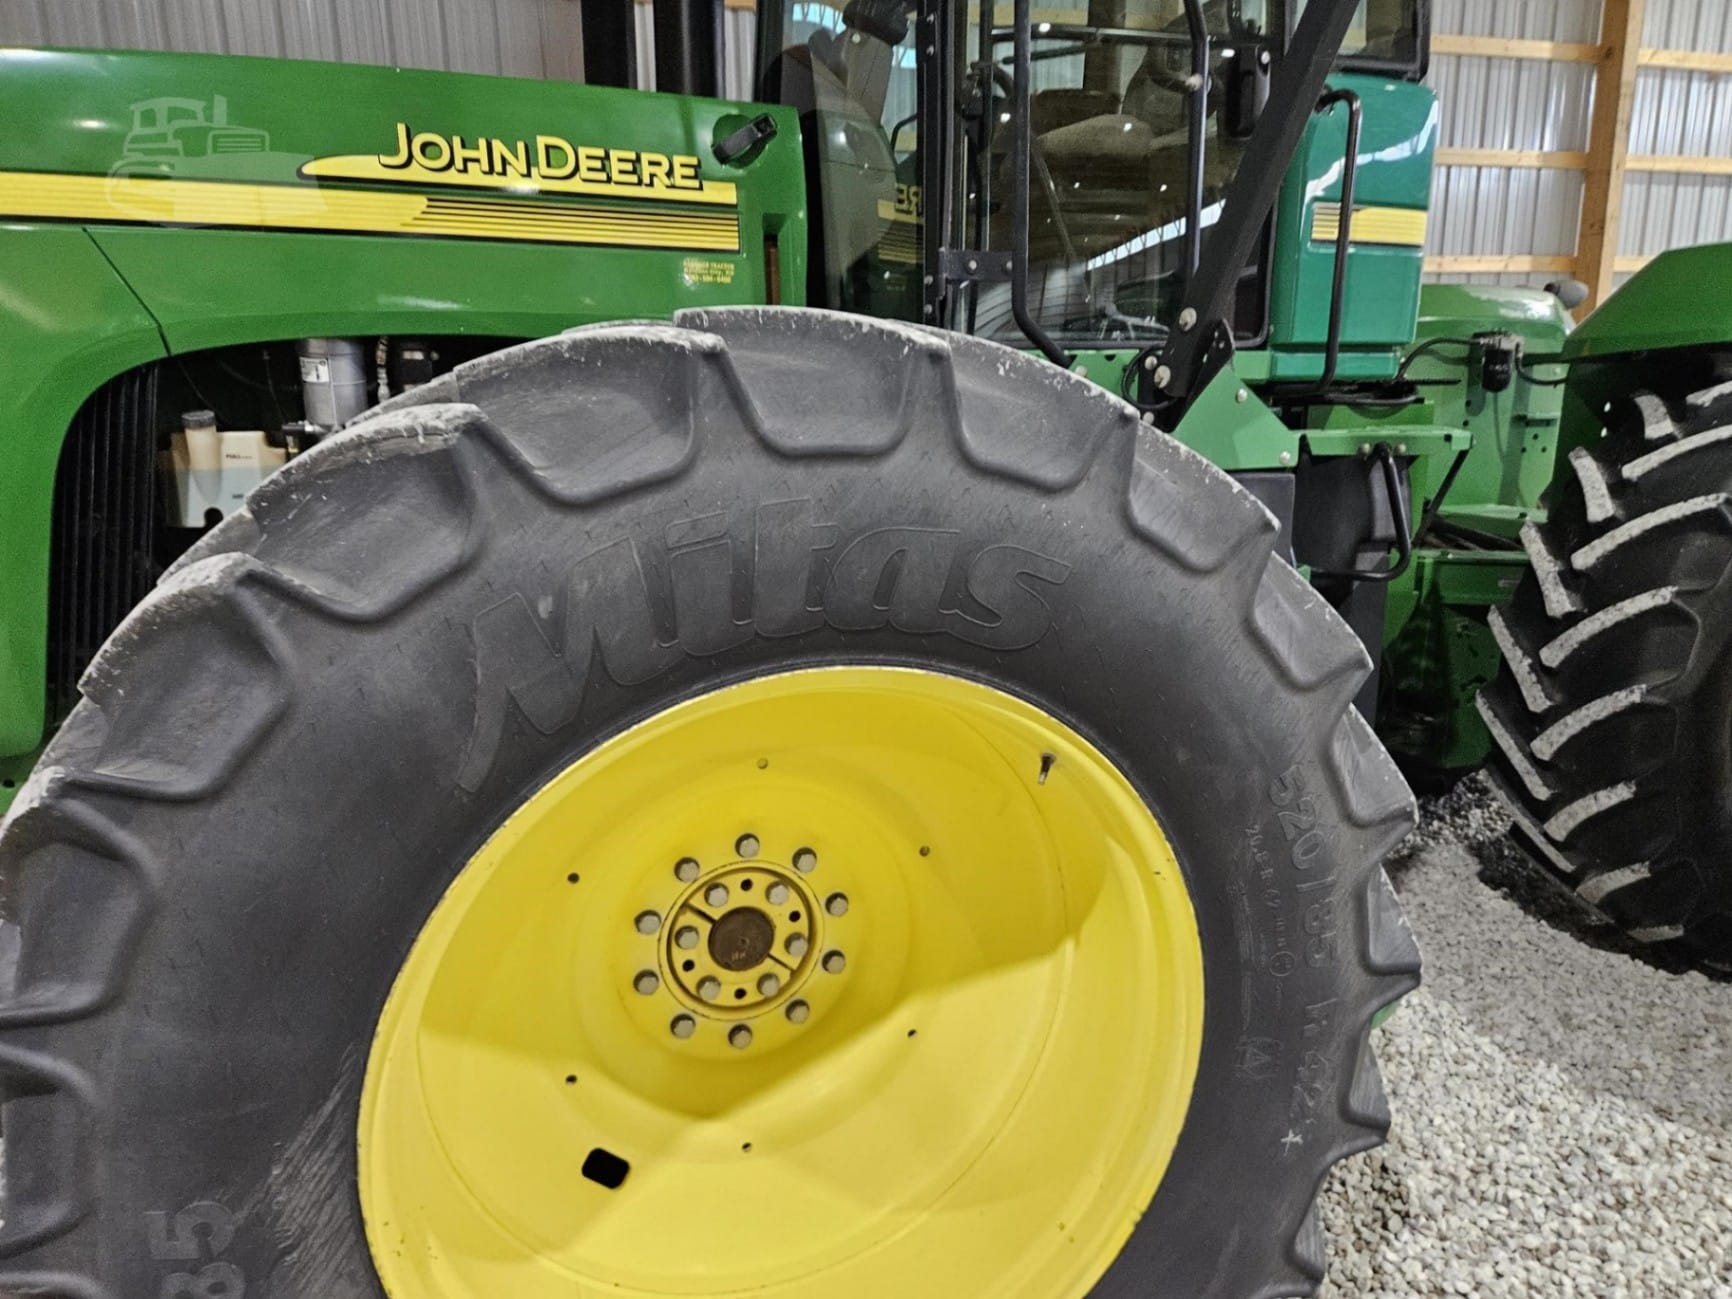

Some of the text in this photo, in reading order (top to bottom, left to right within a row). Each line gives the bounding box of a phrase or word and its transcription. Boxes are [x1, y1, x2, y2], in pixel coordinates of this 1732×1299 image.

[378, 122, 704, 191] JOHN DEERE
[455, 498, 1072, 792] Mitas
